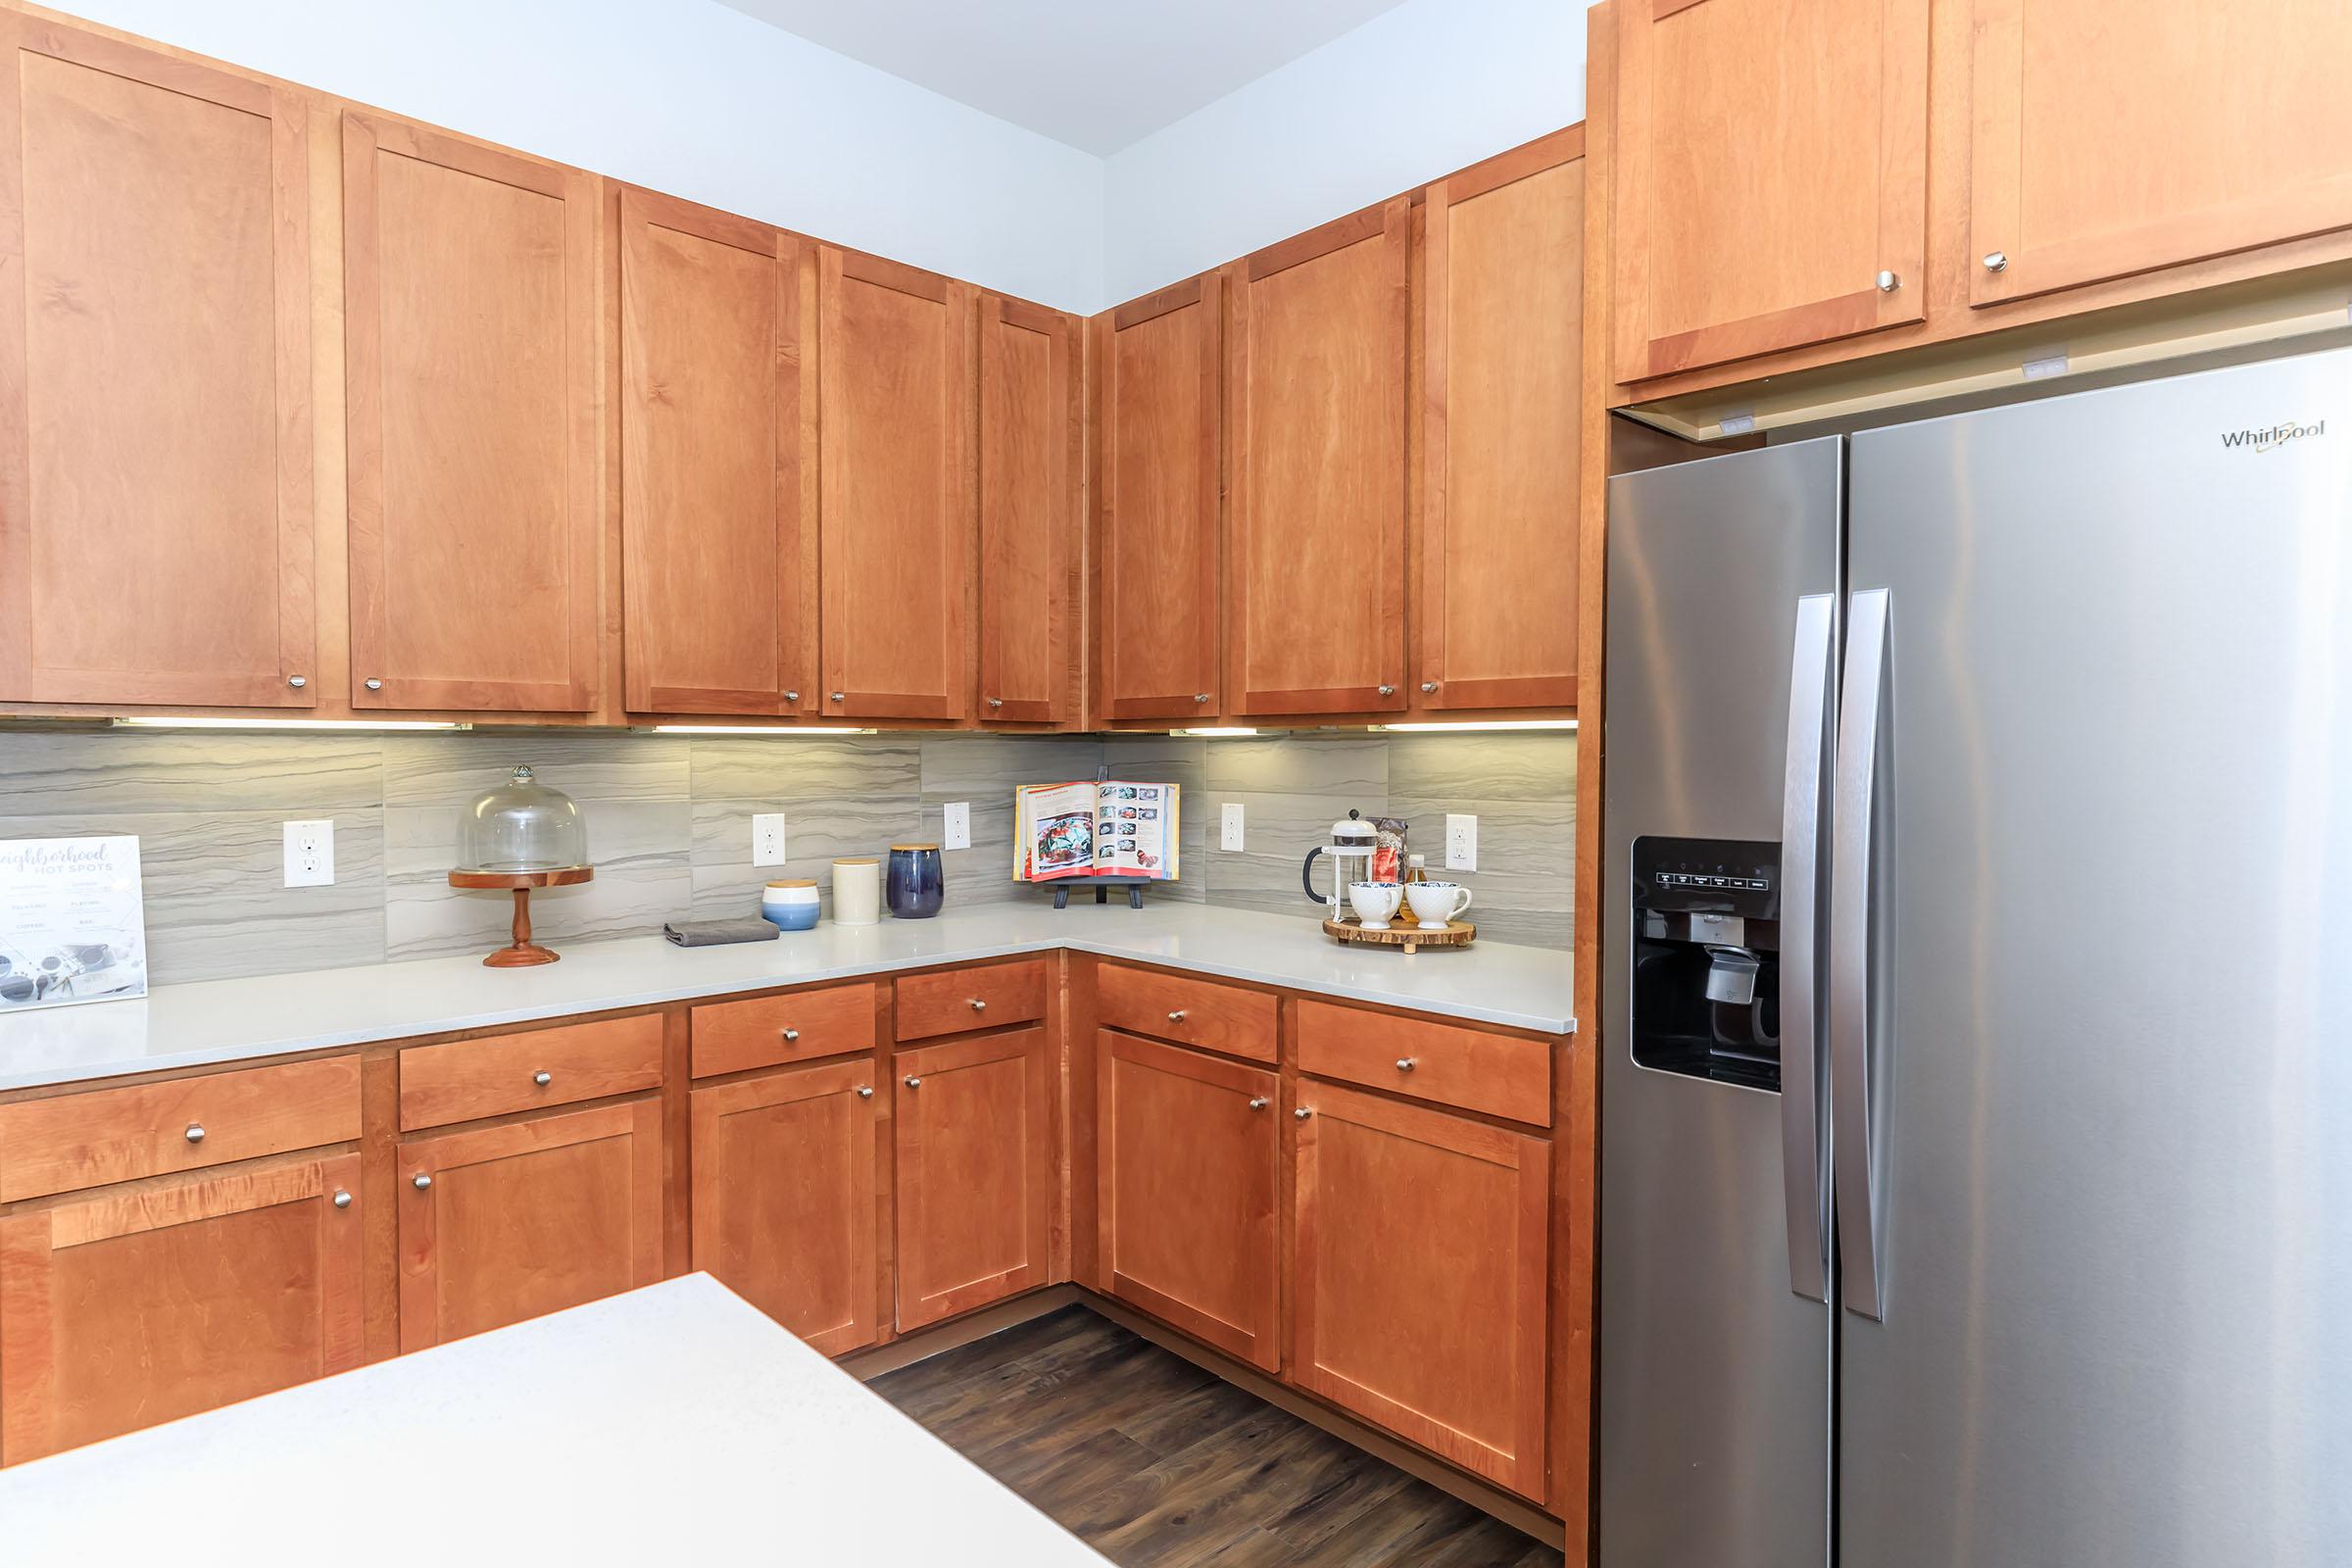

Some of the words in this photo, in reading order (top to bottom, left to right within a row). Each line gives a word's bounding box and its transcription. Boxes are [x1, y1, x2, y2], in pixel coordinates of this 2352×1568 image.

[2222, 419, 2326, 449] Whirlpool
[0, 843, 107, 872] eighborhood
[34, 865, 64, 874] HOT
[69, 862, 113, 873] SPOTS
